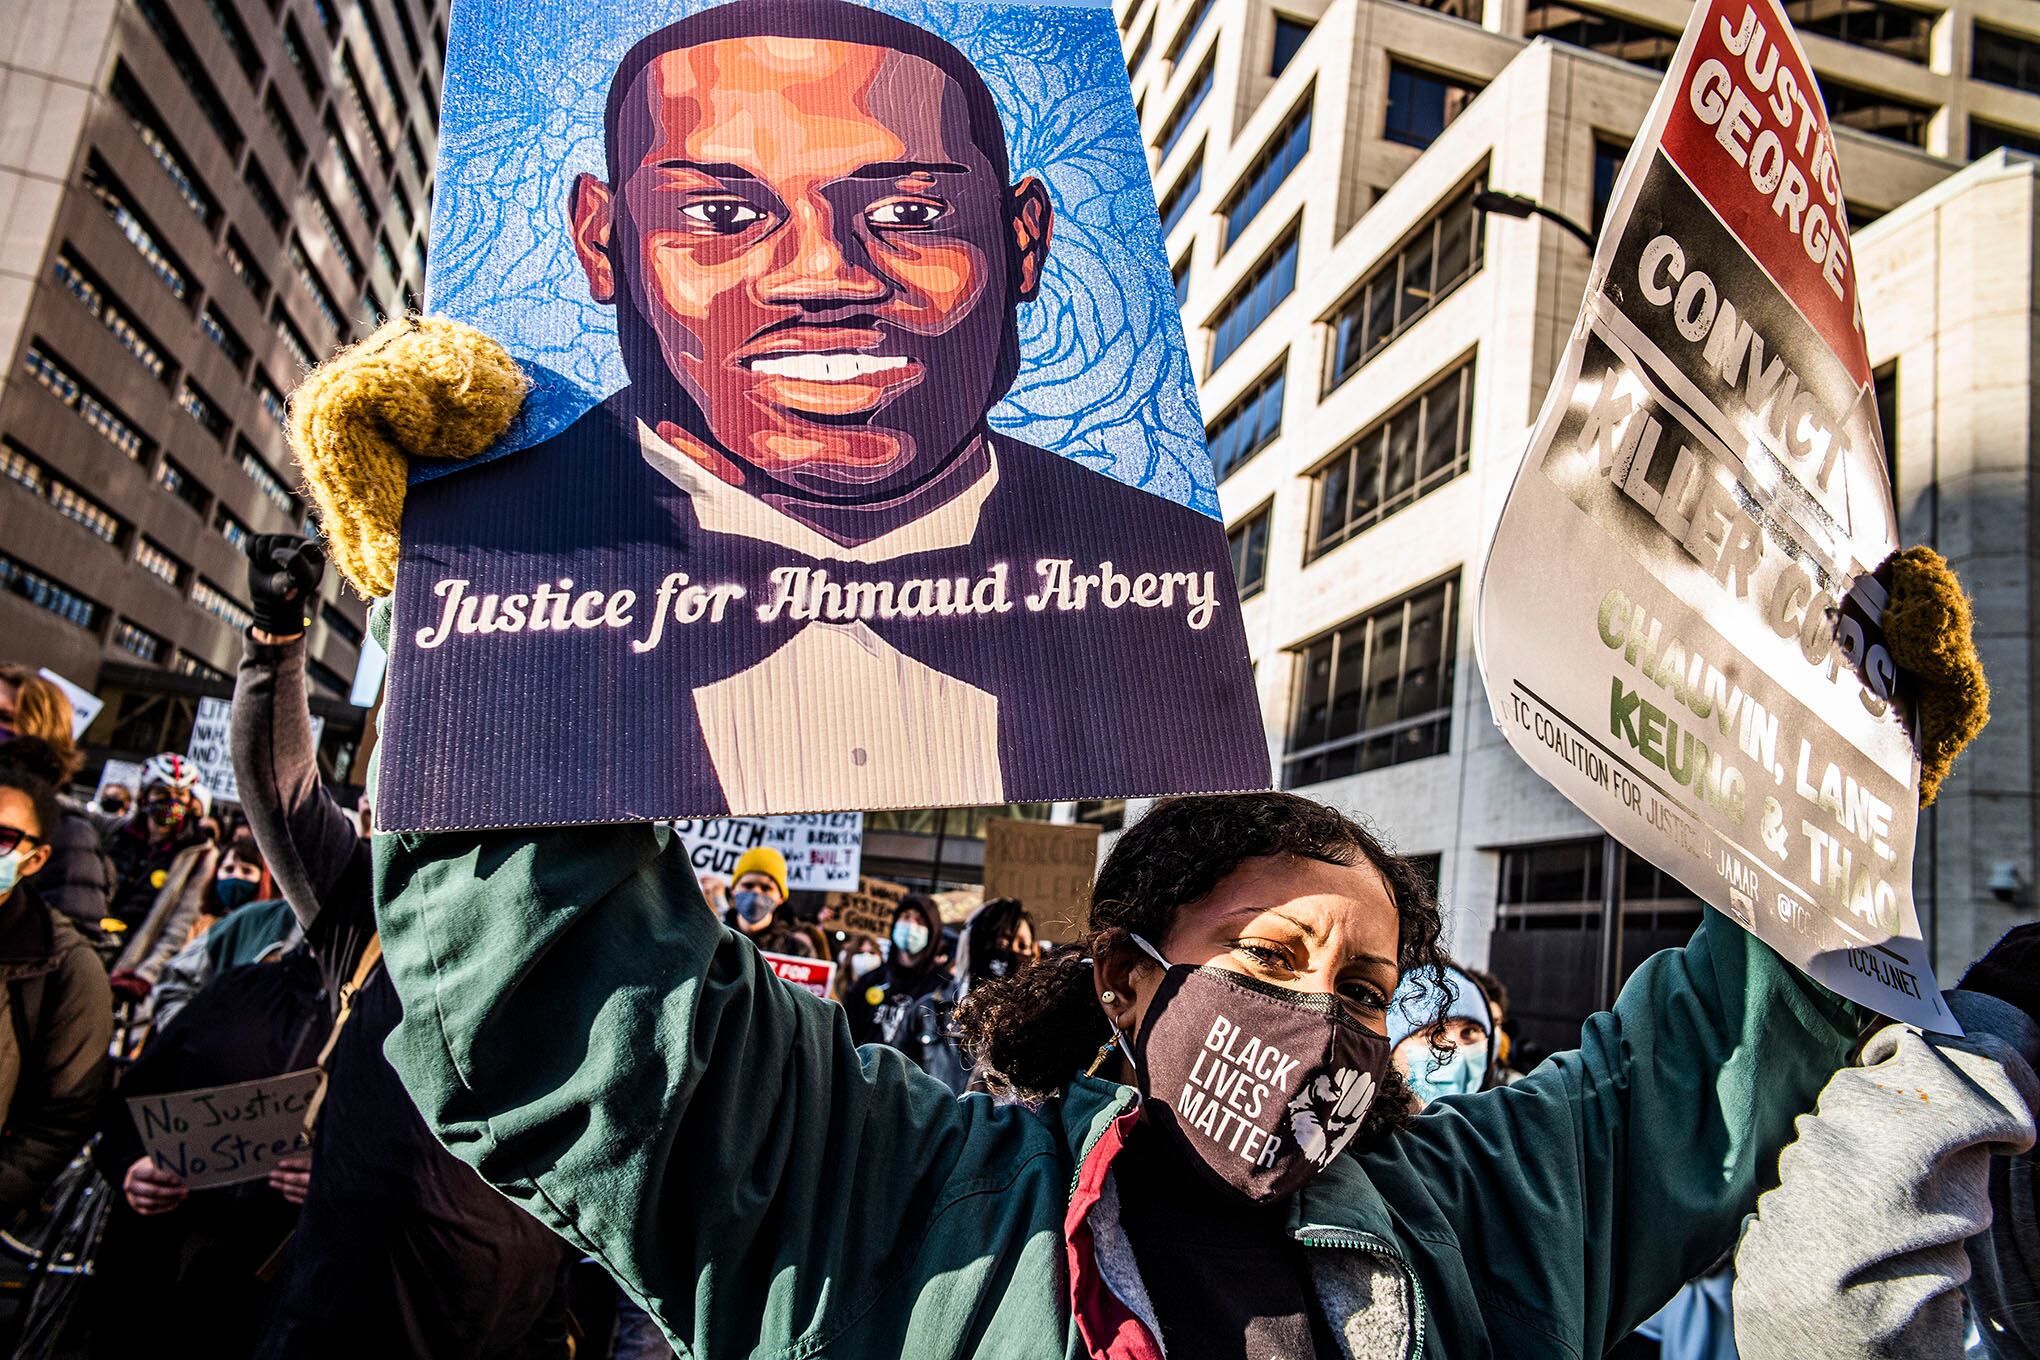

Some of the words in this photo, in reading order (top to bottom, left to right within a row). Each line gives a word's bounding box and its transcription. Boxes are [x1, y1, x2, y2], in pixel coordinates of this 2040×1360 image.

[1690, 59, 1848, 300] GEORGE
[1638, 235, 1852, 494] CONVICT
[1577, 367, 1764, 598] KILLER
[1770, 563, 1893, 718] COPS
[415, 578, 637, 649] Justice
[632, 572, 746, 653] for
[757, 561, 1014, 623] Ahmaud
[1025, 558, 1221, 631] Arbery
[1598, 589, 1785, 786] CHAUVIN,
[1511, 692, 1531, 731] TC
[1535, 712, 1609, 792] COALITION
[1613, 770, 1642, 816] FOR
[1716, 849, 1759, 902] JAMAR
[1844, 939, 1922, 1000] TCC4J.NET
[1609, 675, 1745, 824] KEUNG
[1761, 796, 1788, 861] &
[1801, 820, 1901, 937] THAO
[691, 844, 740, 875] GUI
[779, 963, 811, 981] FOR
[1188, 1049, 1269, 1119] LIVES
[1204, 1015, 1300, 1093] BLACK
[142, 1098, 188, 1139] No
[156, 1142, 206, 1179] No
[1177, 1082, 1282, 1169] MATTER
